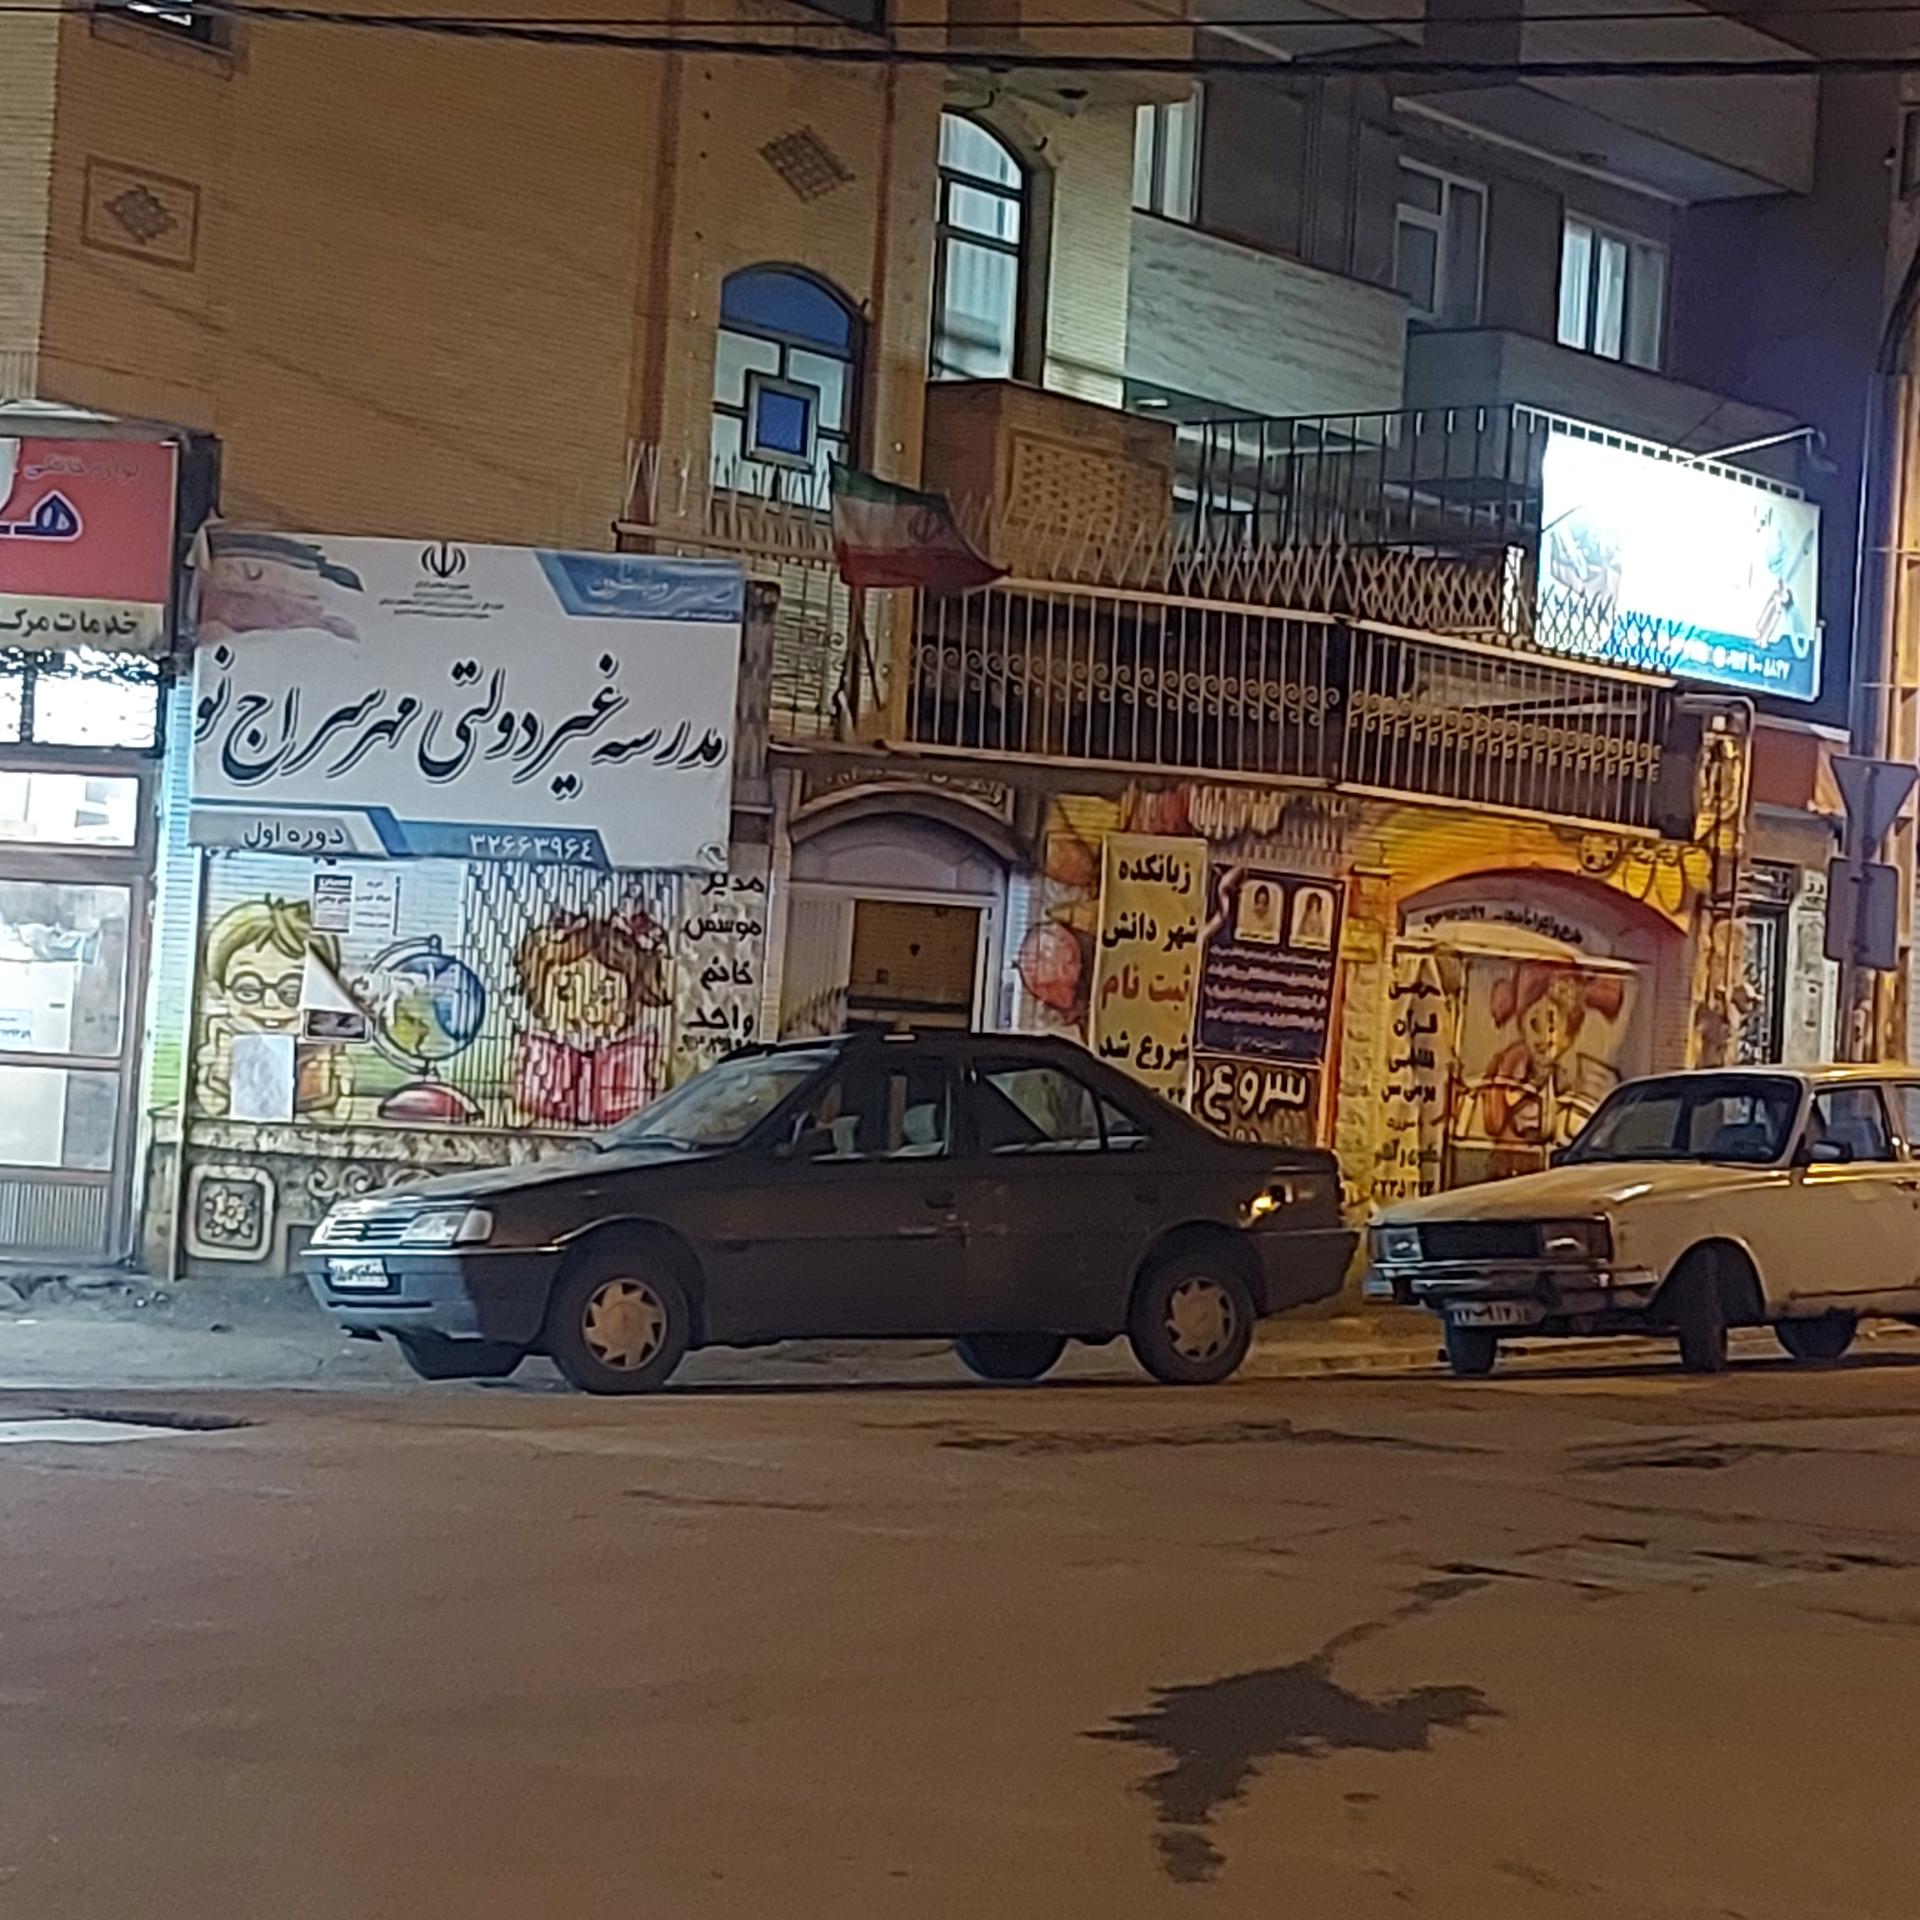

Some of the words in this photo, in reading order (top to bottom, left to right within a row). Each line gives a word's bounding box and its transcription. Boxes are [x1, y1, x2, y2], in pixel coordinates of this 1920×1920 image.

[53, 610, 137, 638] خدمات
[590, 719, 728, 769] مدرسه
[243, 821, 281, 848] اول
[287, 826, 344, 848] دوره
[1118, 853, 1192, 894] زبانکده
[1101, 910, 1158, 949] دانش
[1163, 914, 1198, 952] شهر
[700, 956, 754, 991] خانم
[1100, 962, 1141, 1009] نام
[1149, 964, 1191, 1011] ثبت
